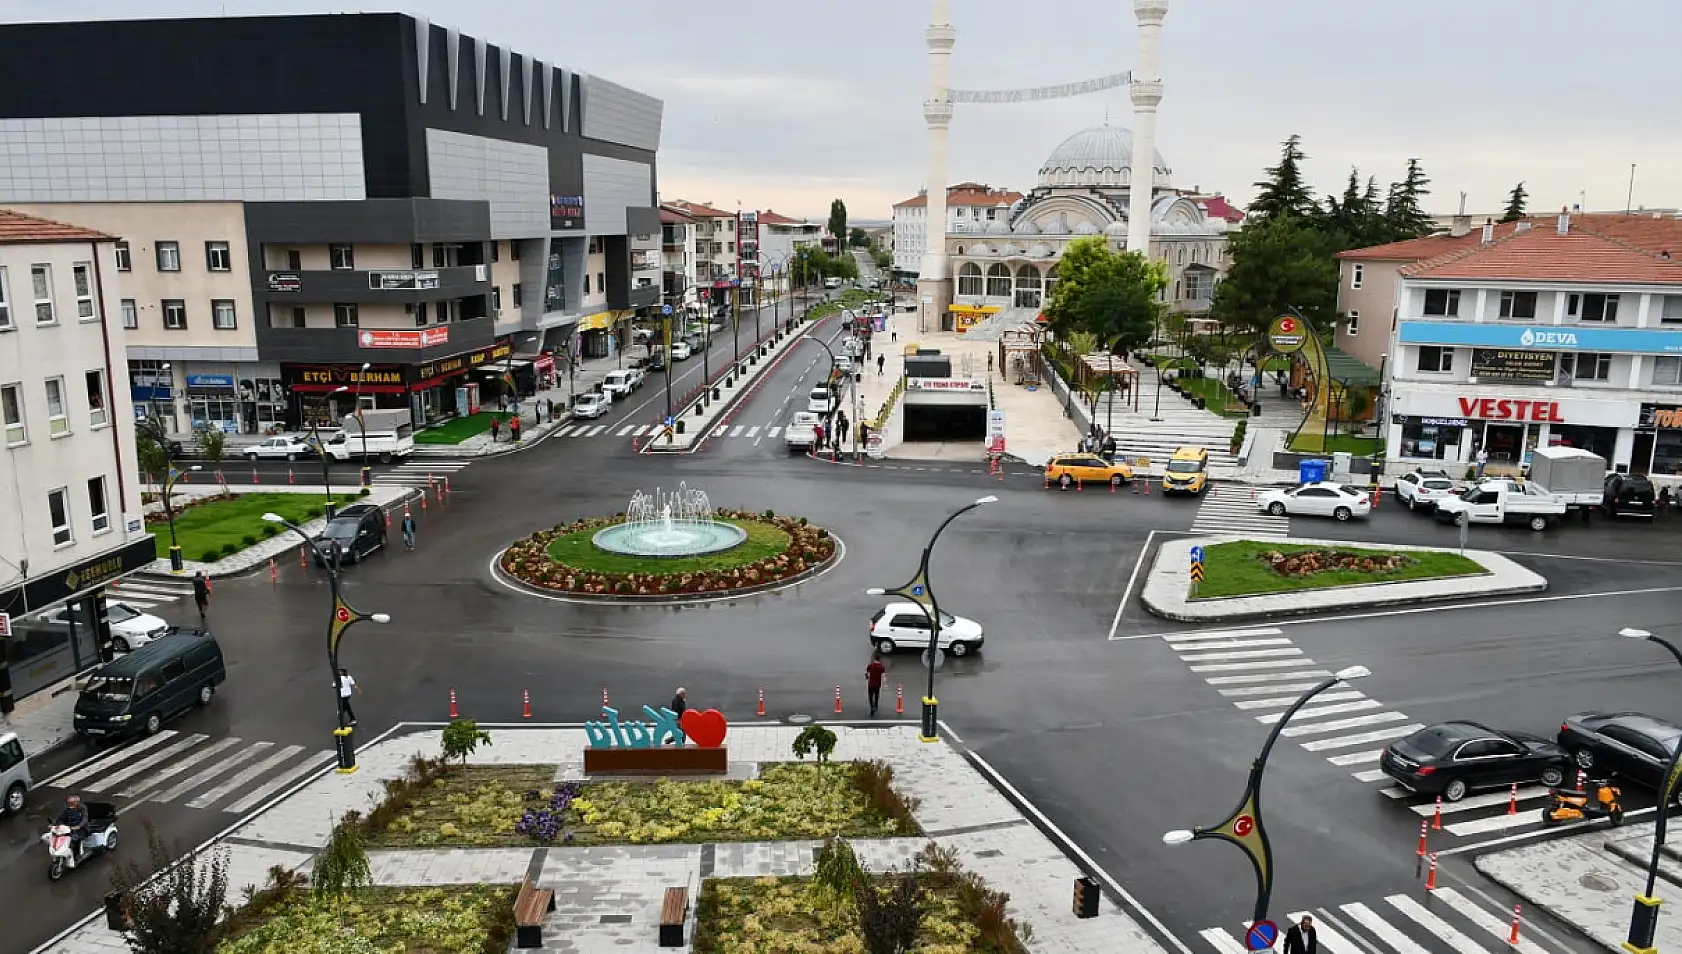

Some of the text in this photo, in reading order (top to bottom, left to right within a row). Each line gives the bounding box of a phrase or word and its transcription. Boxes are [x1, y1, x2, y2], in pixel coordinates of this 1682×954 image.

[1535, 332, 1577, 345] DEVA
[303, 369, 401, 384] ETÇİ BERHAM
[1458, 397, 1565, 423] VESTEL
